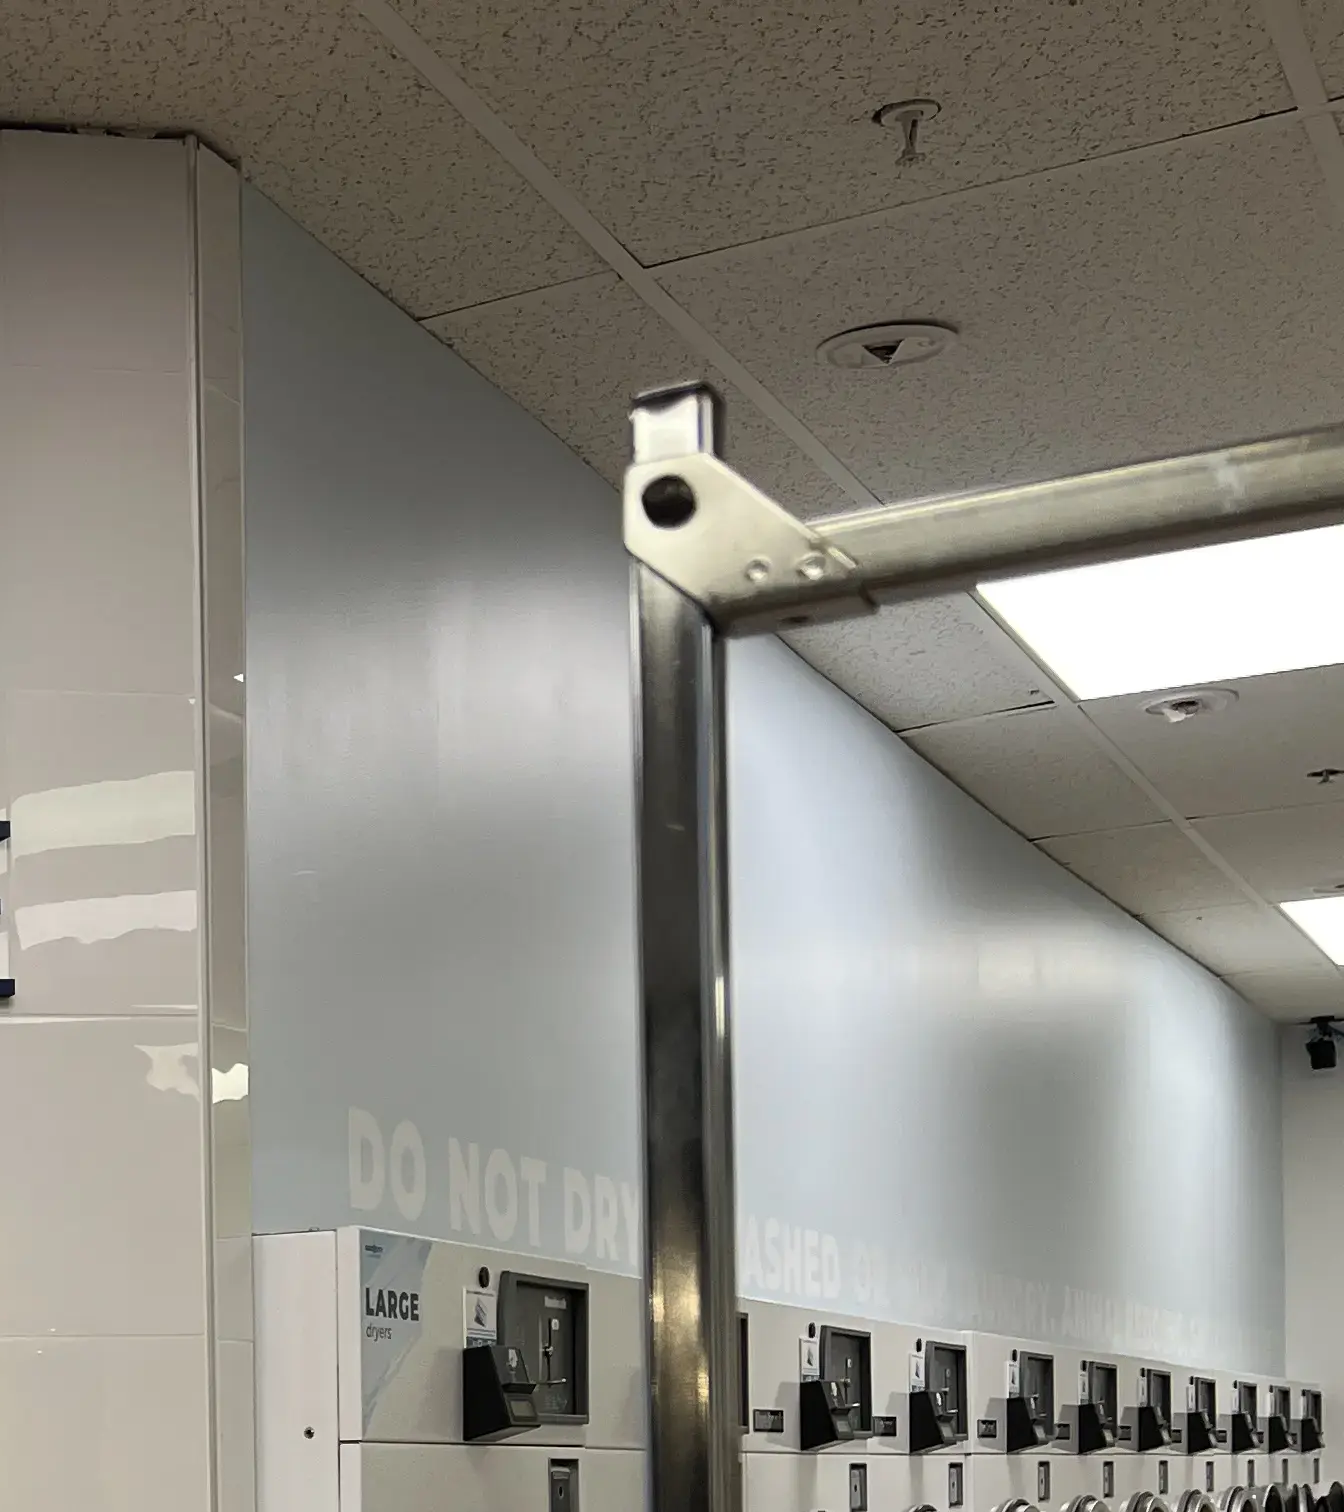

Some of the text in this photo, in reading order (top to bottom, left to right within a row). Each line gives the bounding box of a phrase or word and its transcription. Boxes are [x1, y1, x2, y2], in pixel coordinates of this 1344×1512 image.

[348, 1105, 427, 1222] DO
[448, 1136, 549, 1248] NOT
[564, 1166, 642, 1270] DRY
[741, 1214, 842, 1299] ASHED
[365, 1287, 420, 1321] LARGE
[365, 1323, 393, 1342] dryers
